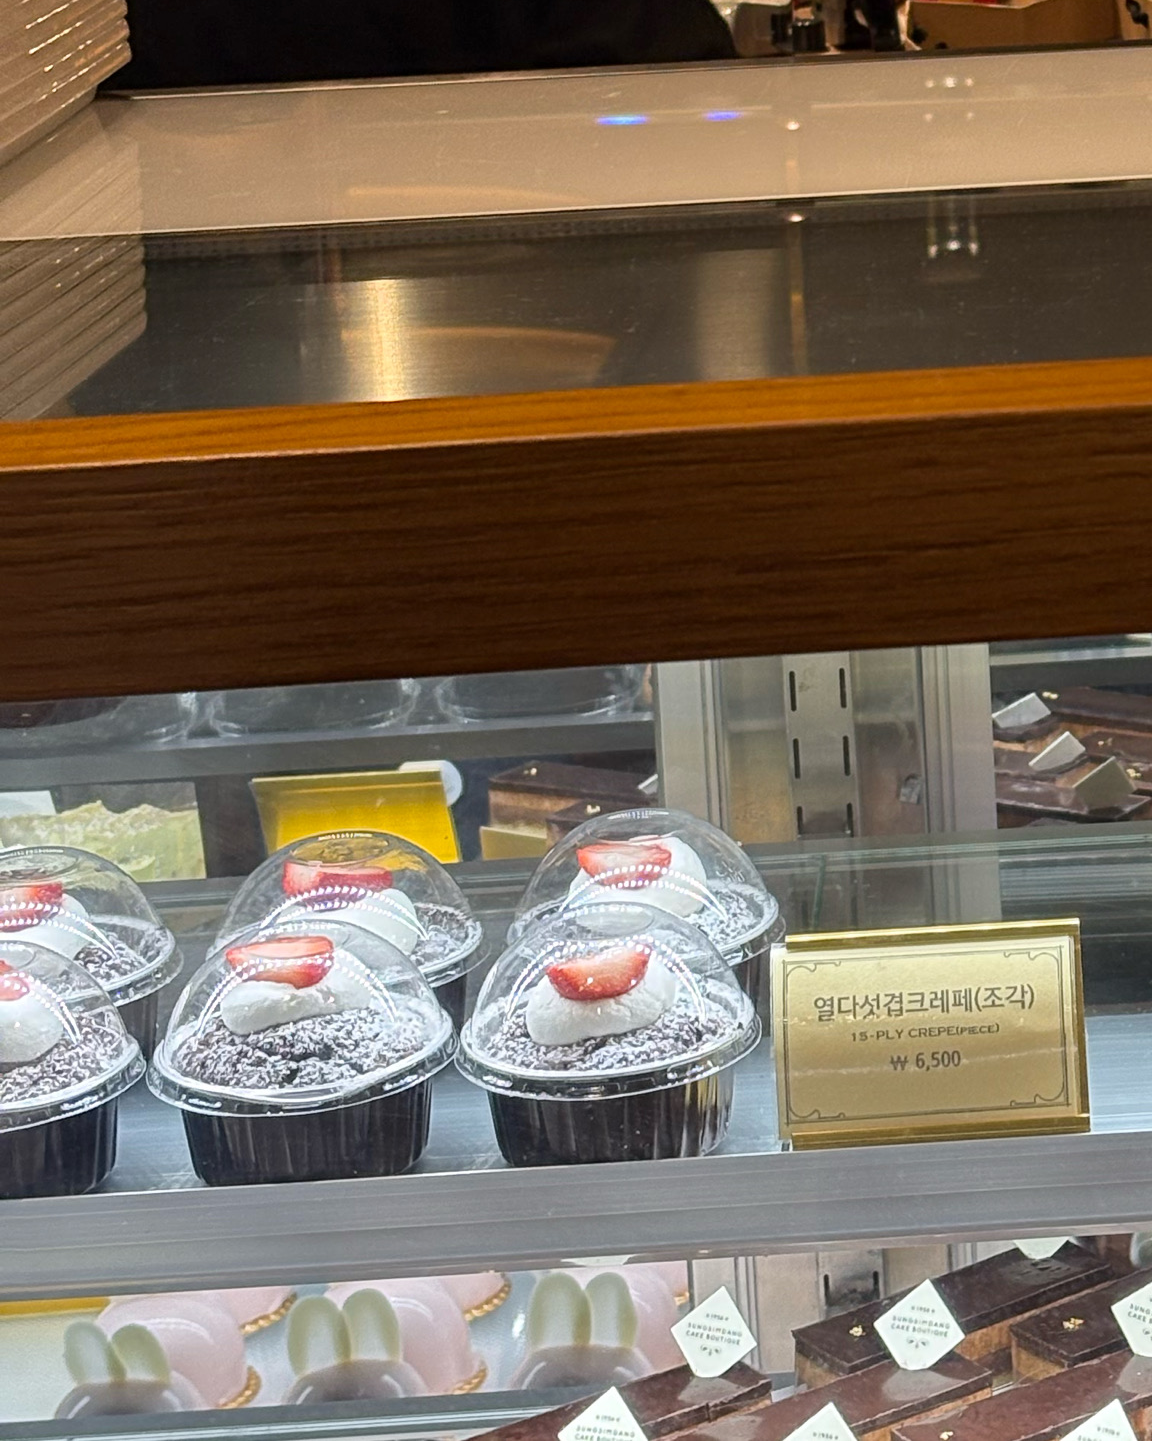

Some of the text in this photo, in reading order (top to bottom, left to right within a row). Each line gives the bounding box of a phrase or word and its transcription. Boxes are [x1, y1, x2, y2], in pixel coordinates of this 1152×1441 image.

[814, 984, 1035, 1022] 열다섯겹크레페(조각)
[851, 1023, 1000, 1043] 15-PLY CREPE(PIECE)
[915, 1050, 961, 1071] 6,500
[1128, 1311, 1146, 1322] CAKE
[686, 1330, 740, 1345] CAKE BOUTIQUE
[891, 1323, 948, 1338] CAKE BOUTIQUE
